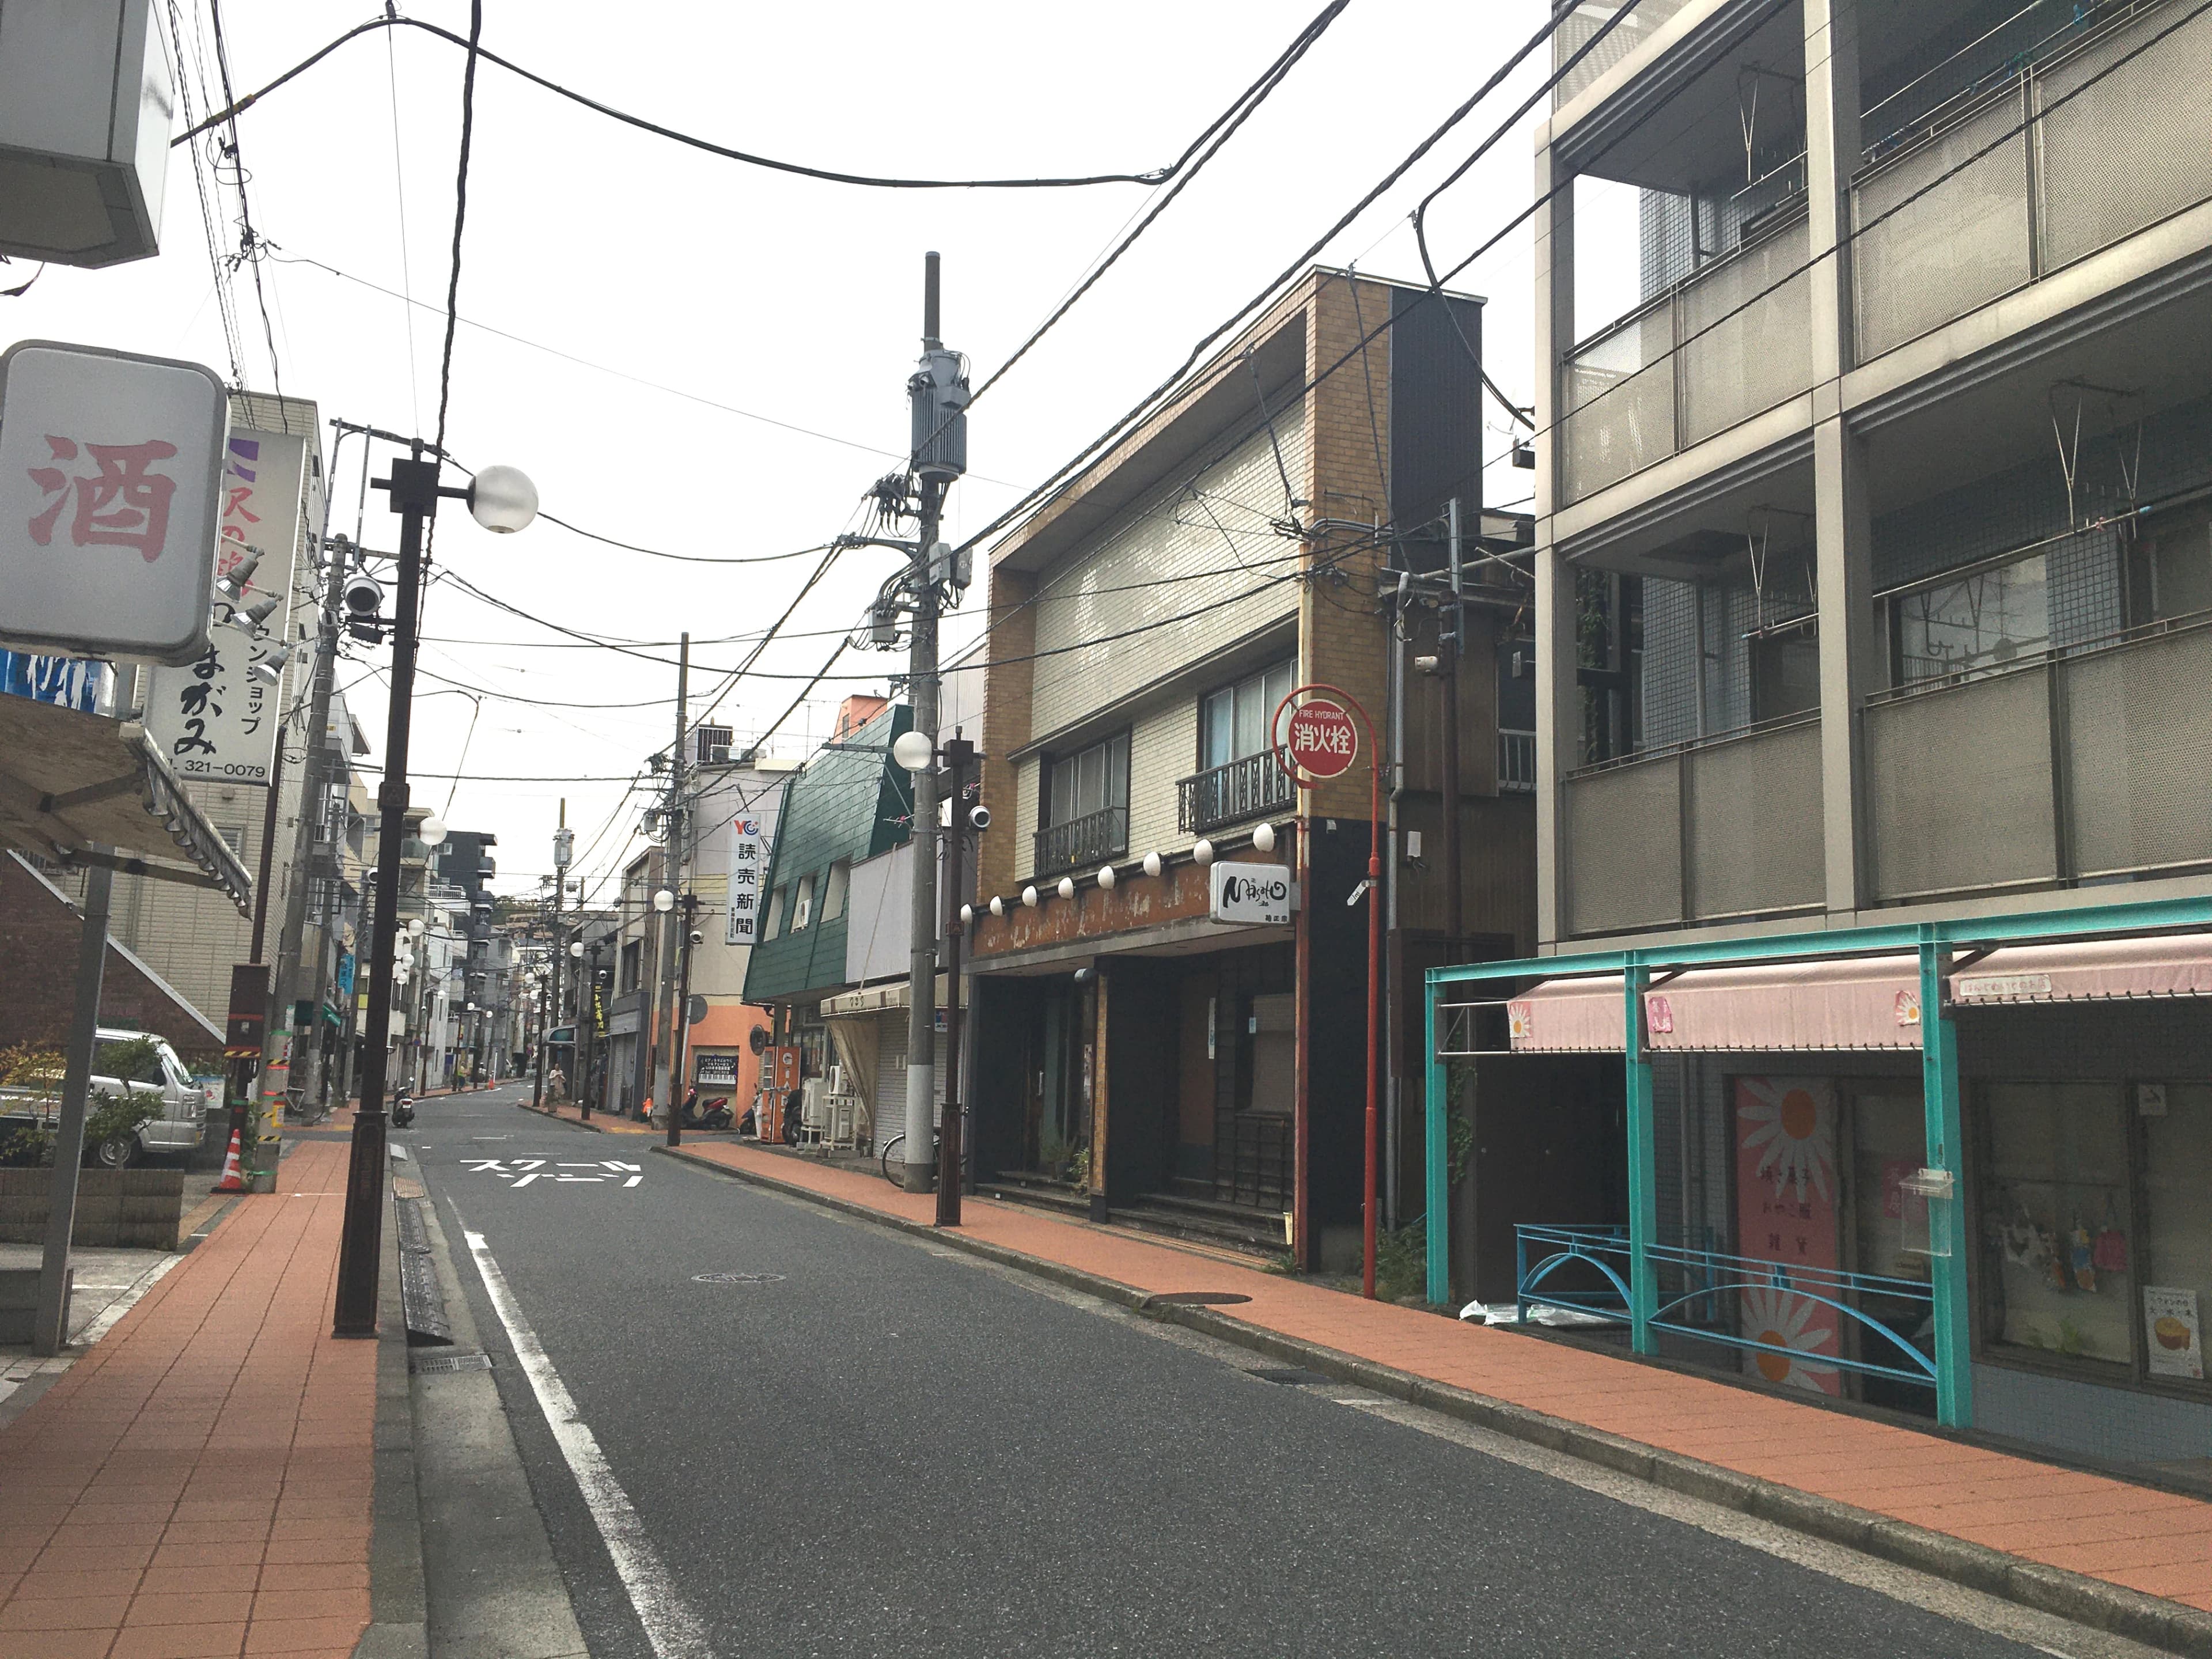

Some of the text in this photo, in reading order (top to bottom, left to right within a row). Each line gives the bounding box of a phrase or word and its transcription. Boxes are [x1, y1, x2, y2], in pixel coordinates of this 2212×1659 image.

[27, 434, 178, 563] 酒
[1299, 709, 1344, 721] FIRE HYDRANT
[1294, 722, 1351, 754] 消火栓
[184, 760, 266, 778] 321-0079
[736, 843, 756, 935] 読売新聞
[459, 1160, 641, 1171] スクール
[496, 1173, 643, 1187] ゾーン
